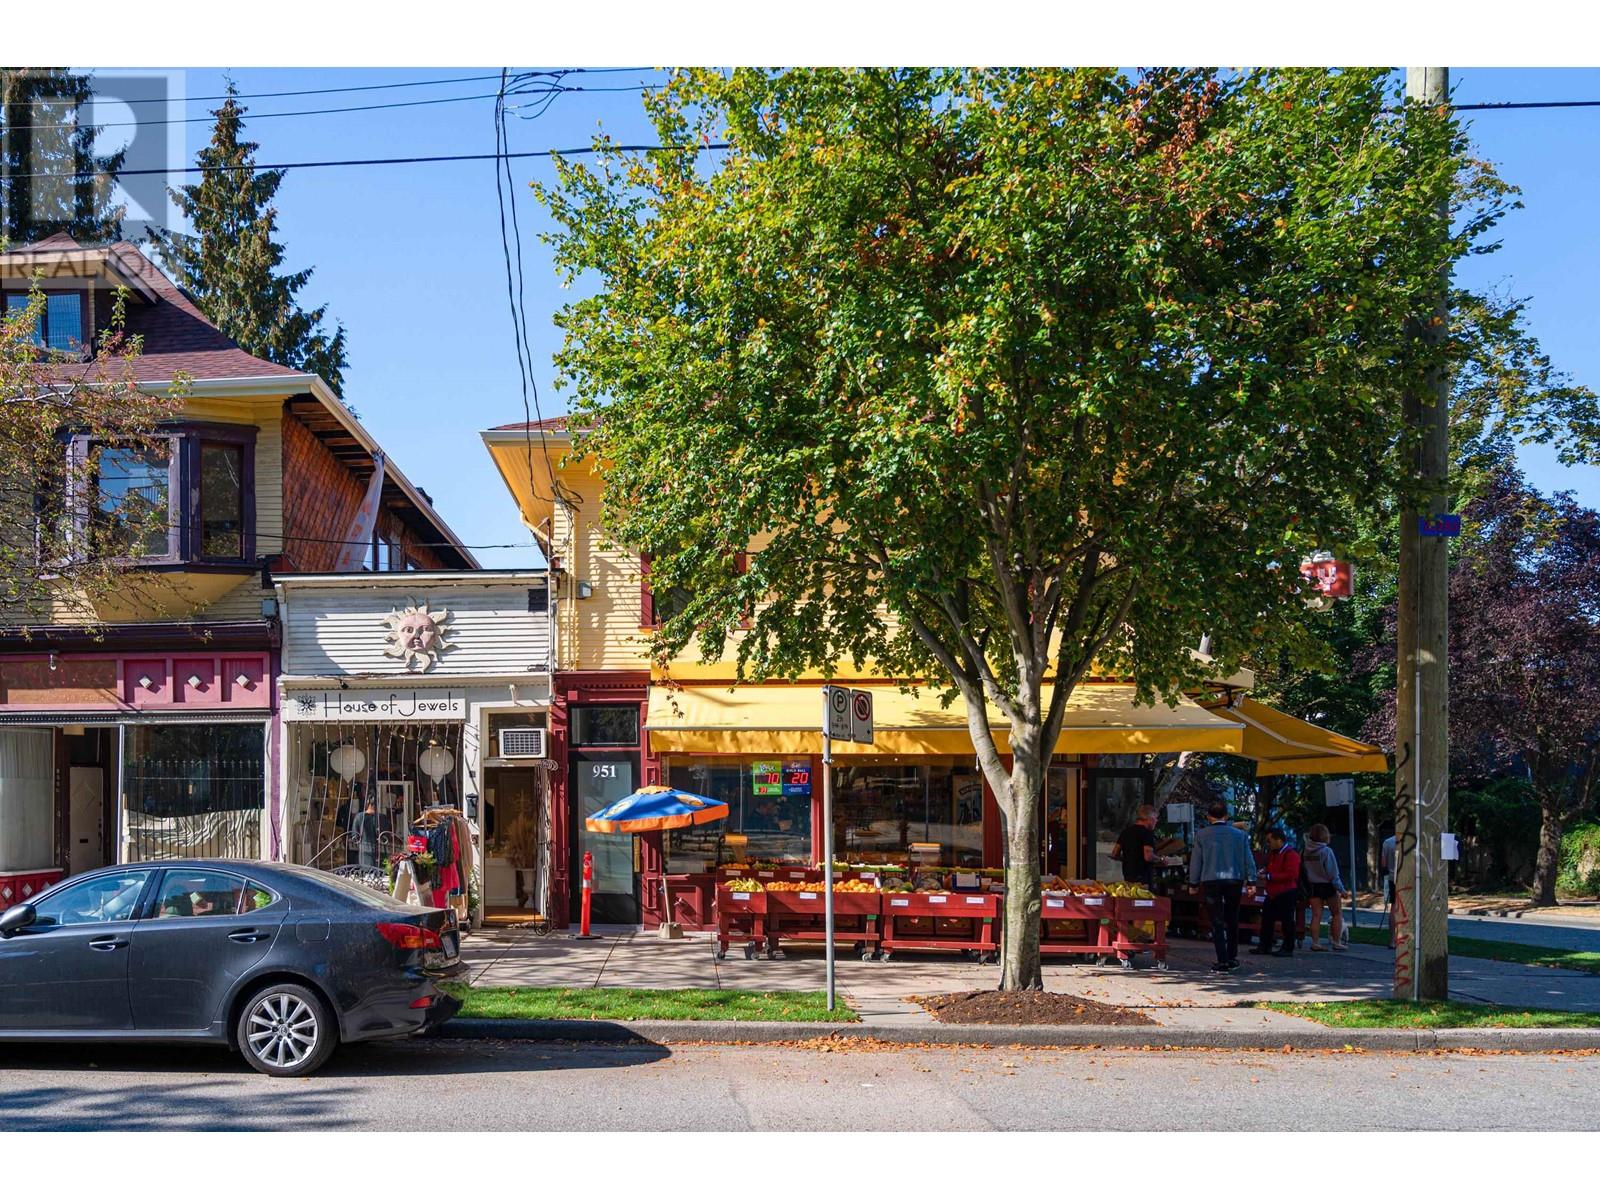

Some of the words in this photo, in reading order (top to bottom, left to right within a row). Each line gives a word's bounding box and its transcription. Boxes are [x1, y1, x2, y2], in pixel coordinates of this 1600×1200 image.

[324, 693, 377, 717] House
[381, 693, 397, 714] of
[399, 691, 459, 717] Jewels
[592, 764, 616, 778] 951
[791, 772, 808, 784] 20
